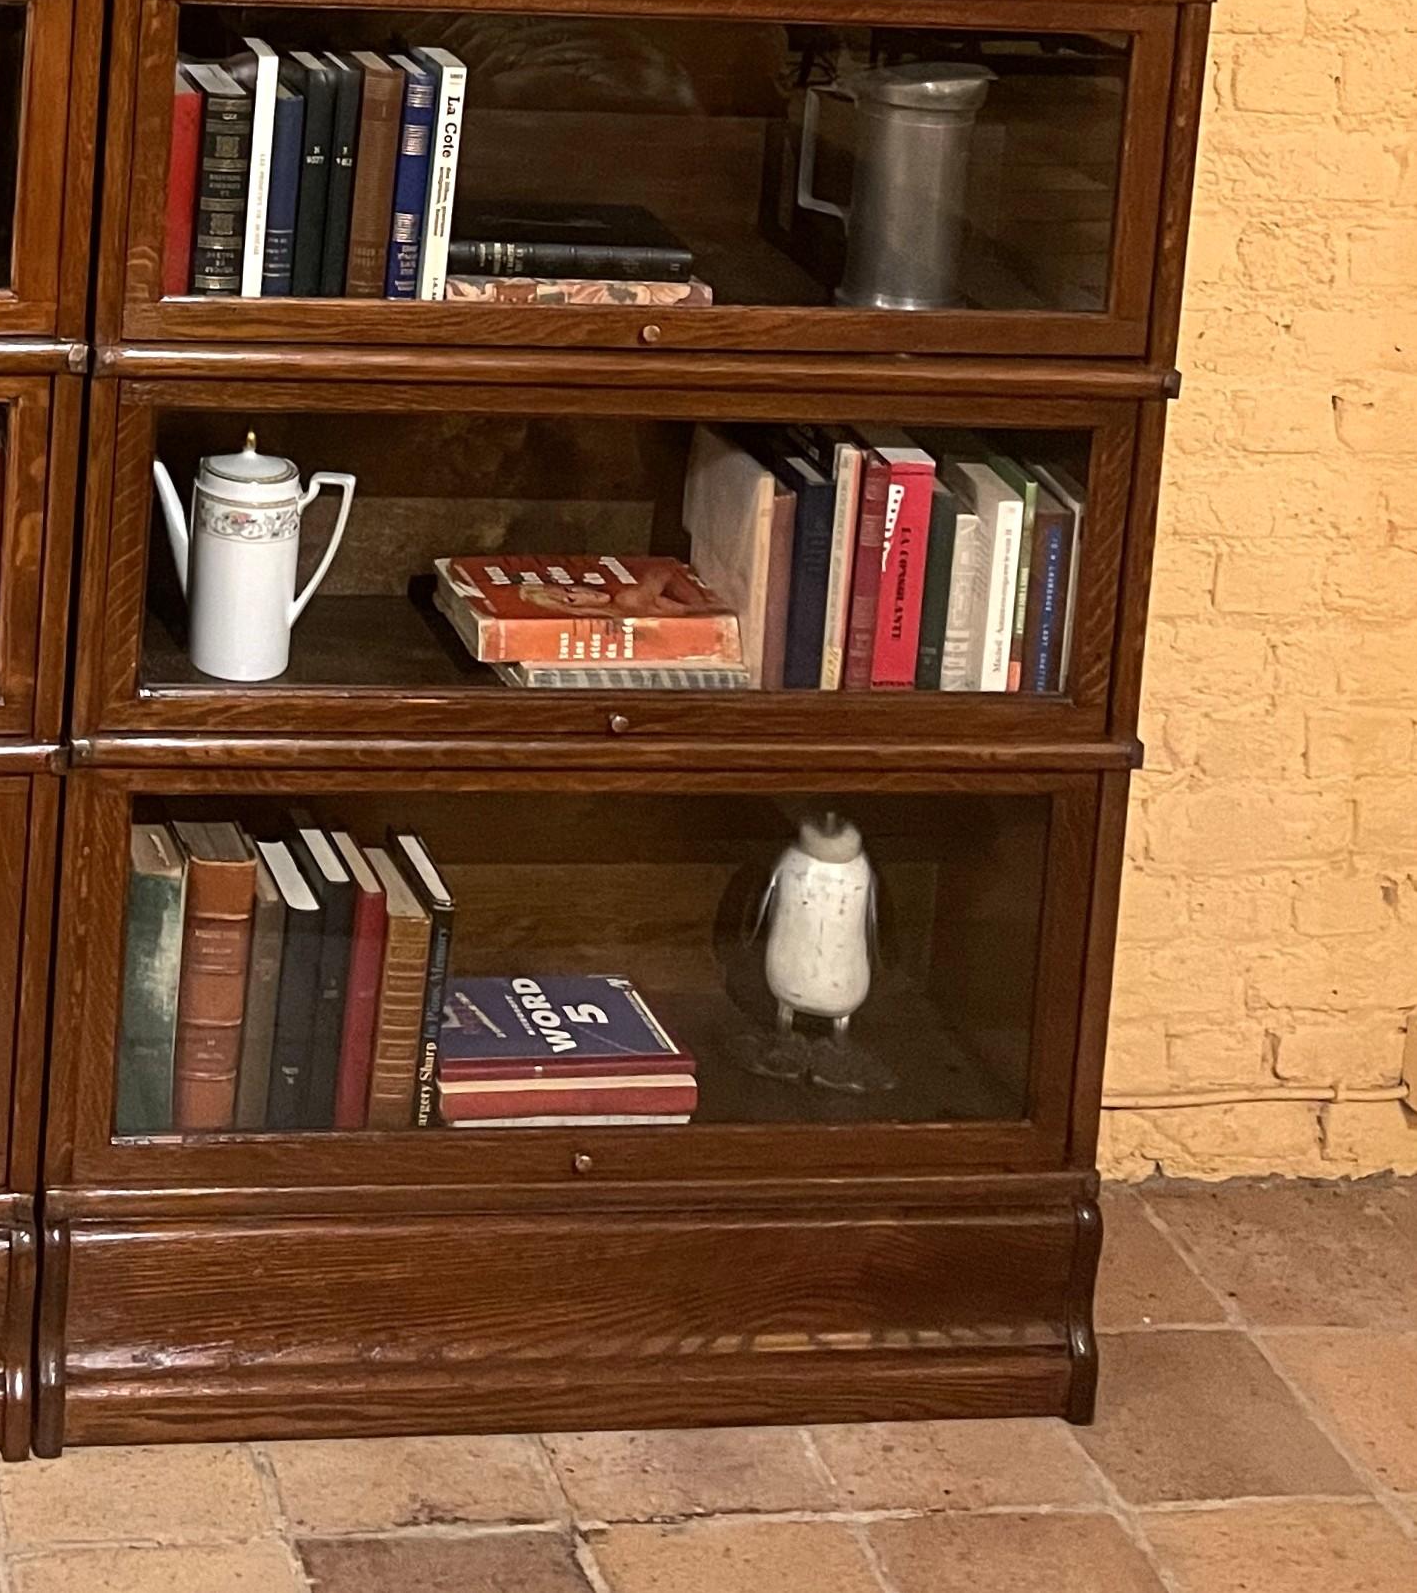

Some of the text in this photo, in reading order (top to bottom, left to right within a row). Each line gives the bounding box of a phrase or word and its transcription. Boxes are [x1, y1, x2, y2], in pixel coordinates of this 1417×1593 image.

[442, 96, 461, 159] La Cote
[890, 527, 912, 642] LA CONSOLANTE
[558, 632, 569, 660] tous
[573, 641, 585, 659] les
[605, 644, 617, 659] du
[429, 926, 451, 983] Memory
[425, 986, 443, 1023] Pious
[512, 977, 578, 1054] WORD
[561, 1003, 610, 1025] 5
[423, 1024, 438, 1039] In
[418, 1041, 438, 1082] Sharp
